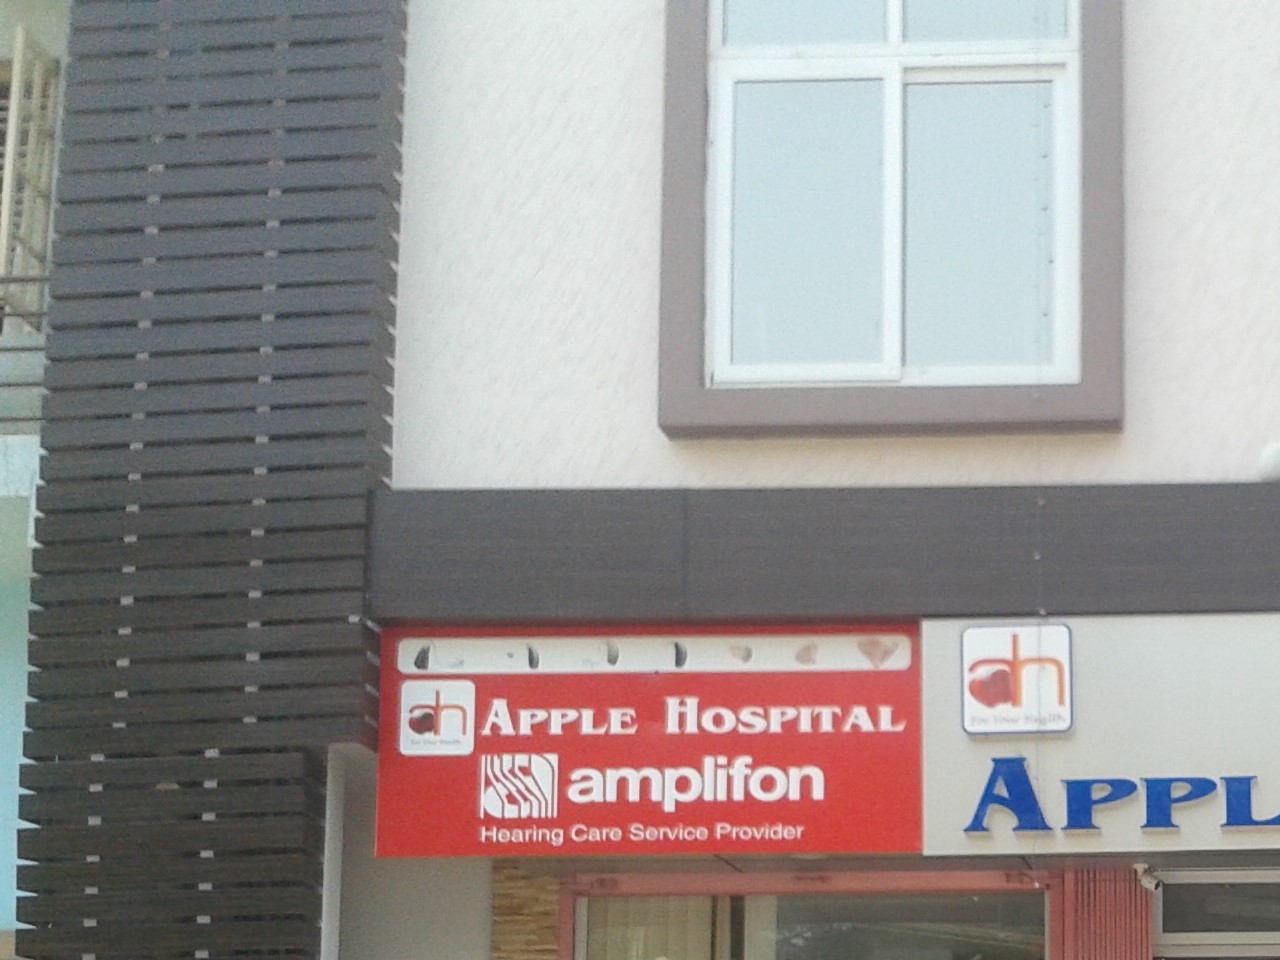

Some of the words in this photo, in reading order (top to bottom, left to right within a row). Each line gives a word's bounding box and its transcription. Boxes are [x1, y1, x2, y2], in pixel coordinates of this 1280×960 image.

[482, 699, 637, 736] APPLE
[664, 697, 906, 734] HOSPITAL
[567, 755, 825, 813] amplifon
[480, 826, 564, 845] Hearing
[570, 825, 623, 842] Care
[629, 824, 709, 842] Service
[715, 822, 804, 840] Provider
